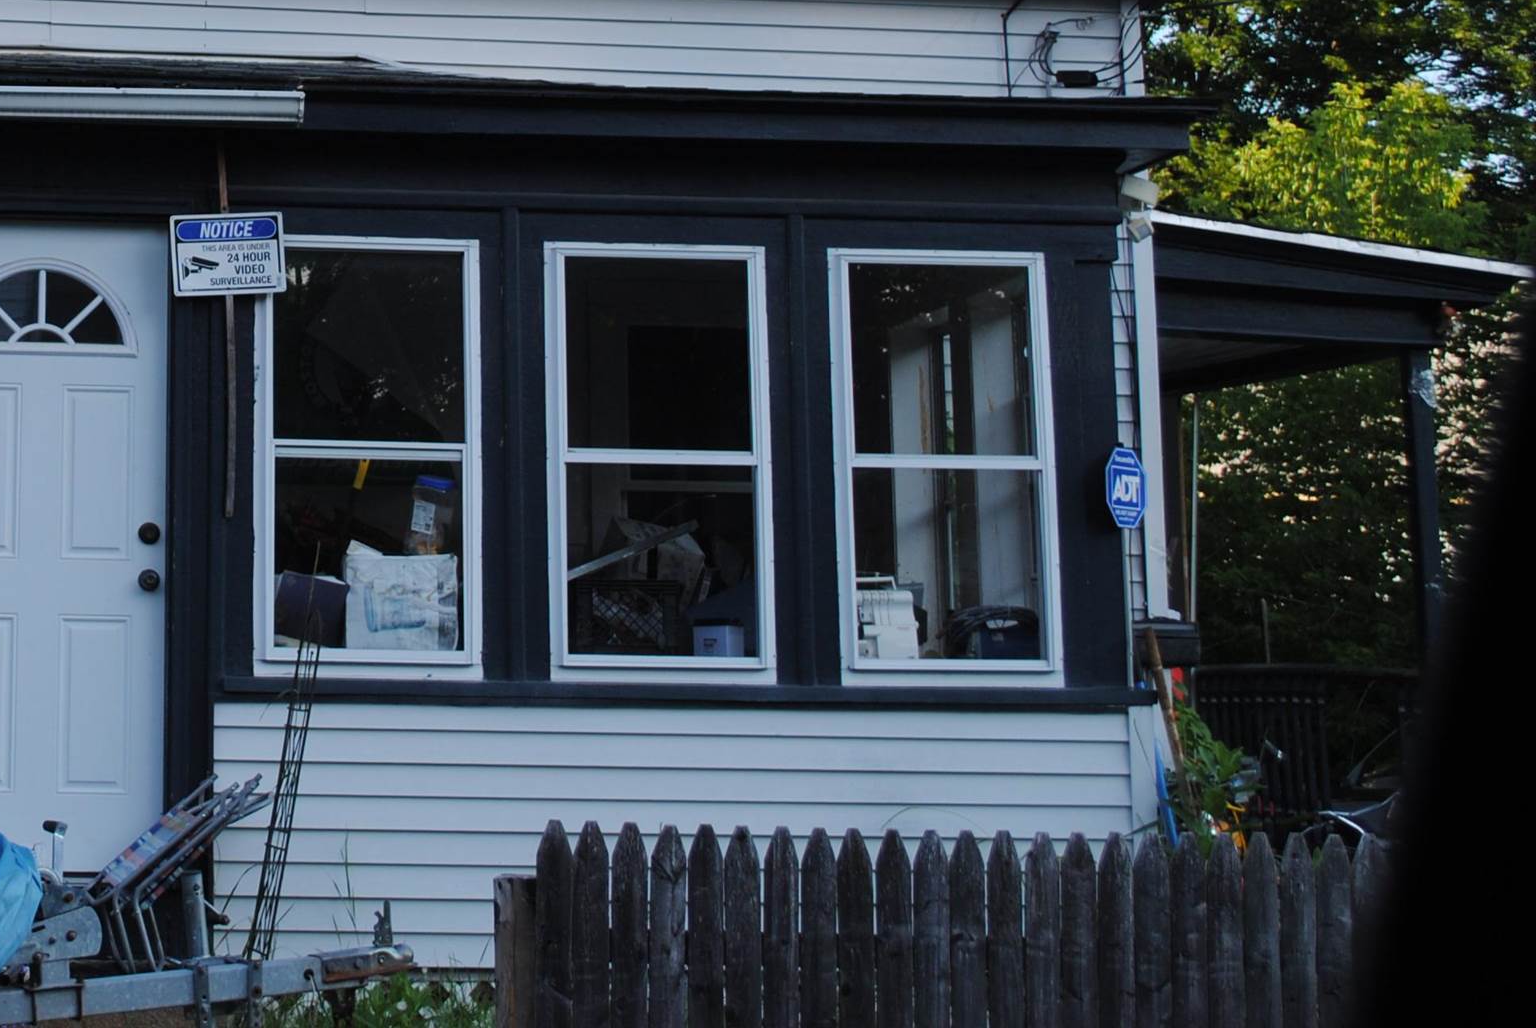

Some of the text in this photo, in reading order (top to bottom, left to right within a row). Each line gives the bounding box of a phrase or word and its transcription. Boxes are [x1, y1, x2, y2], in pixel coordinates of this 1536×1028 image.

[199, 221, 254, 239] NOTICE
[218, 244, 237, 252] AREA
[246, 242, 271, 251] UNDER
[227, 251, 271, 263] 24 HOUR
[234, 264, 265, 275] VIDEO
[210, 275, 272, 287] SURVEILLANCE
[1112, 474, 1140, 503] ADT
